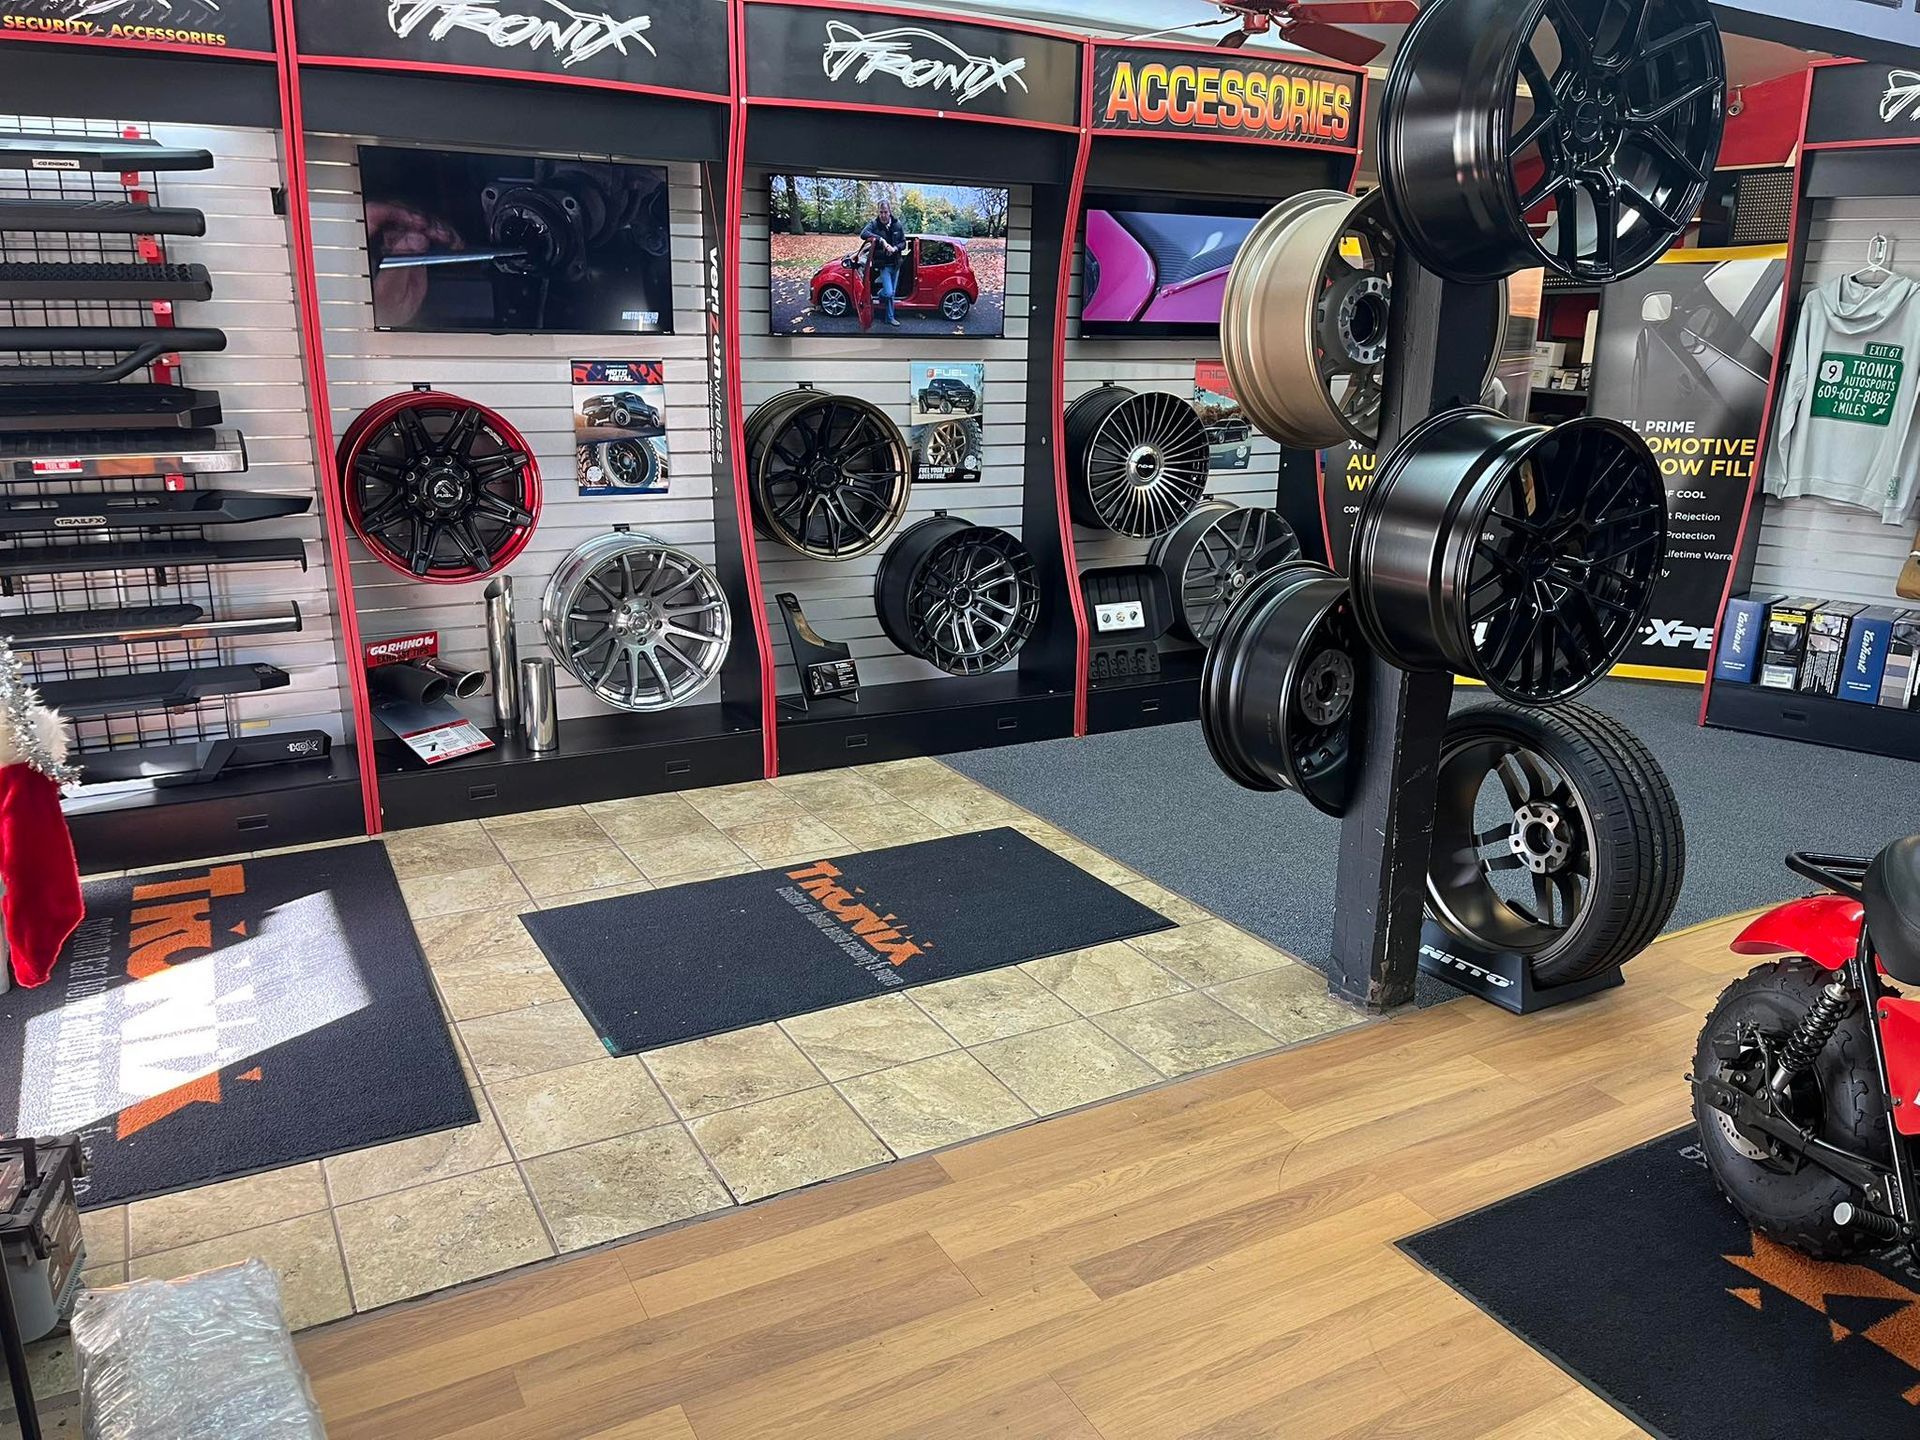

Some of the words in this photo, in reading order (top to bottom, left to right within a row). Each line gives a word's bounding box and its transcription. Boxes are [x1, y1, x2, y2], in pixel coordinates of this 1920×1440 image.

[3, 15, 93, 34] SECURITY
[111, 24, 226, 46] ACCESSORIES
[824, 41, 1026, 105] TRONIX
[1102, 61, 1352, 141] ACCESSORIES
[1869, 345, 1888, 357] EXIT
[1889, 347, 1900, 358] 67
[935, 369, 968, 377] FUEL
[1829, 365, 1838, 379] 9
[1852, 360, 1896, 379] TRONIX
[1844, 376, 1896, 392] AUTOSPORTS
[1817, 385, 1891, 406] 609-607-8882
[1645, 421, 1695, 433] PRIME
[1656, 458, 1704, 476] OW
[1677, 490, 1707, 499] COOL
[1675, 512, 1720, 521] Rejection
[1732, 611, 1749, 654] Carhartt
[370, 643, 387, 656] GO
[387, 637, 424, 653] RHINO
[1857, 629, 1876, 674] Carhartt
[1419, 944, 1510, 988] NITTO
